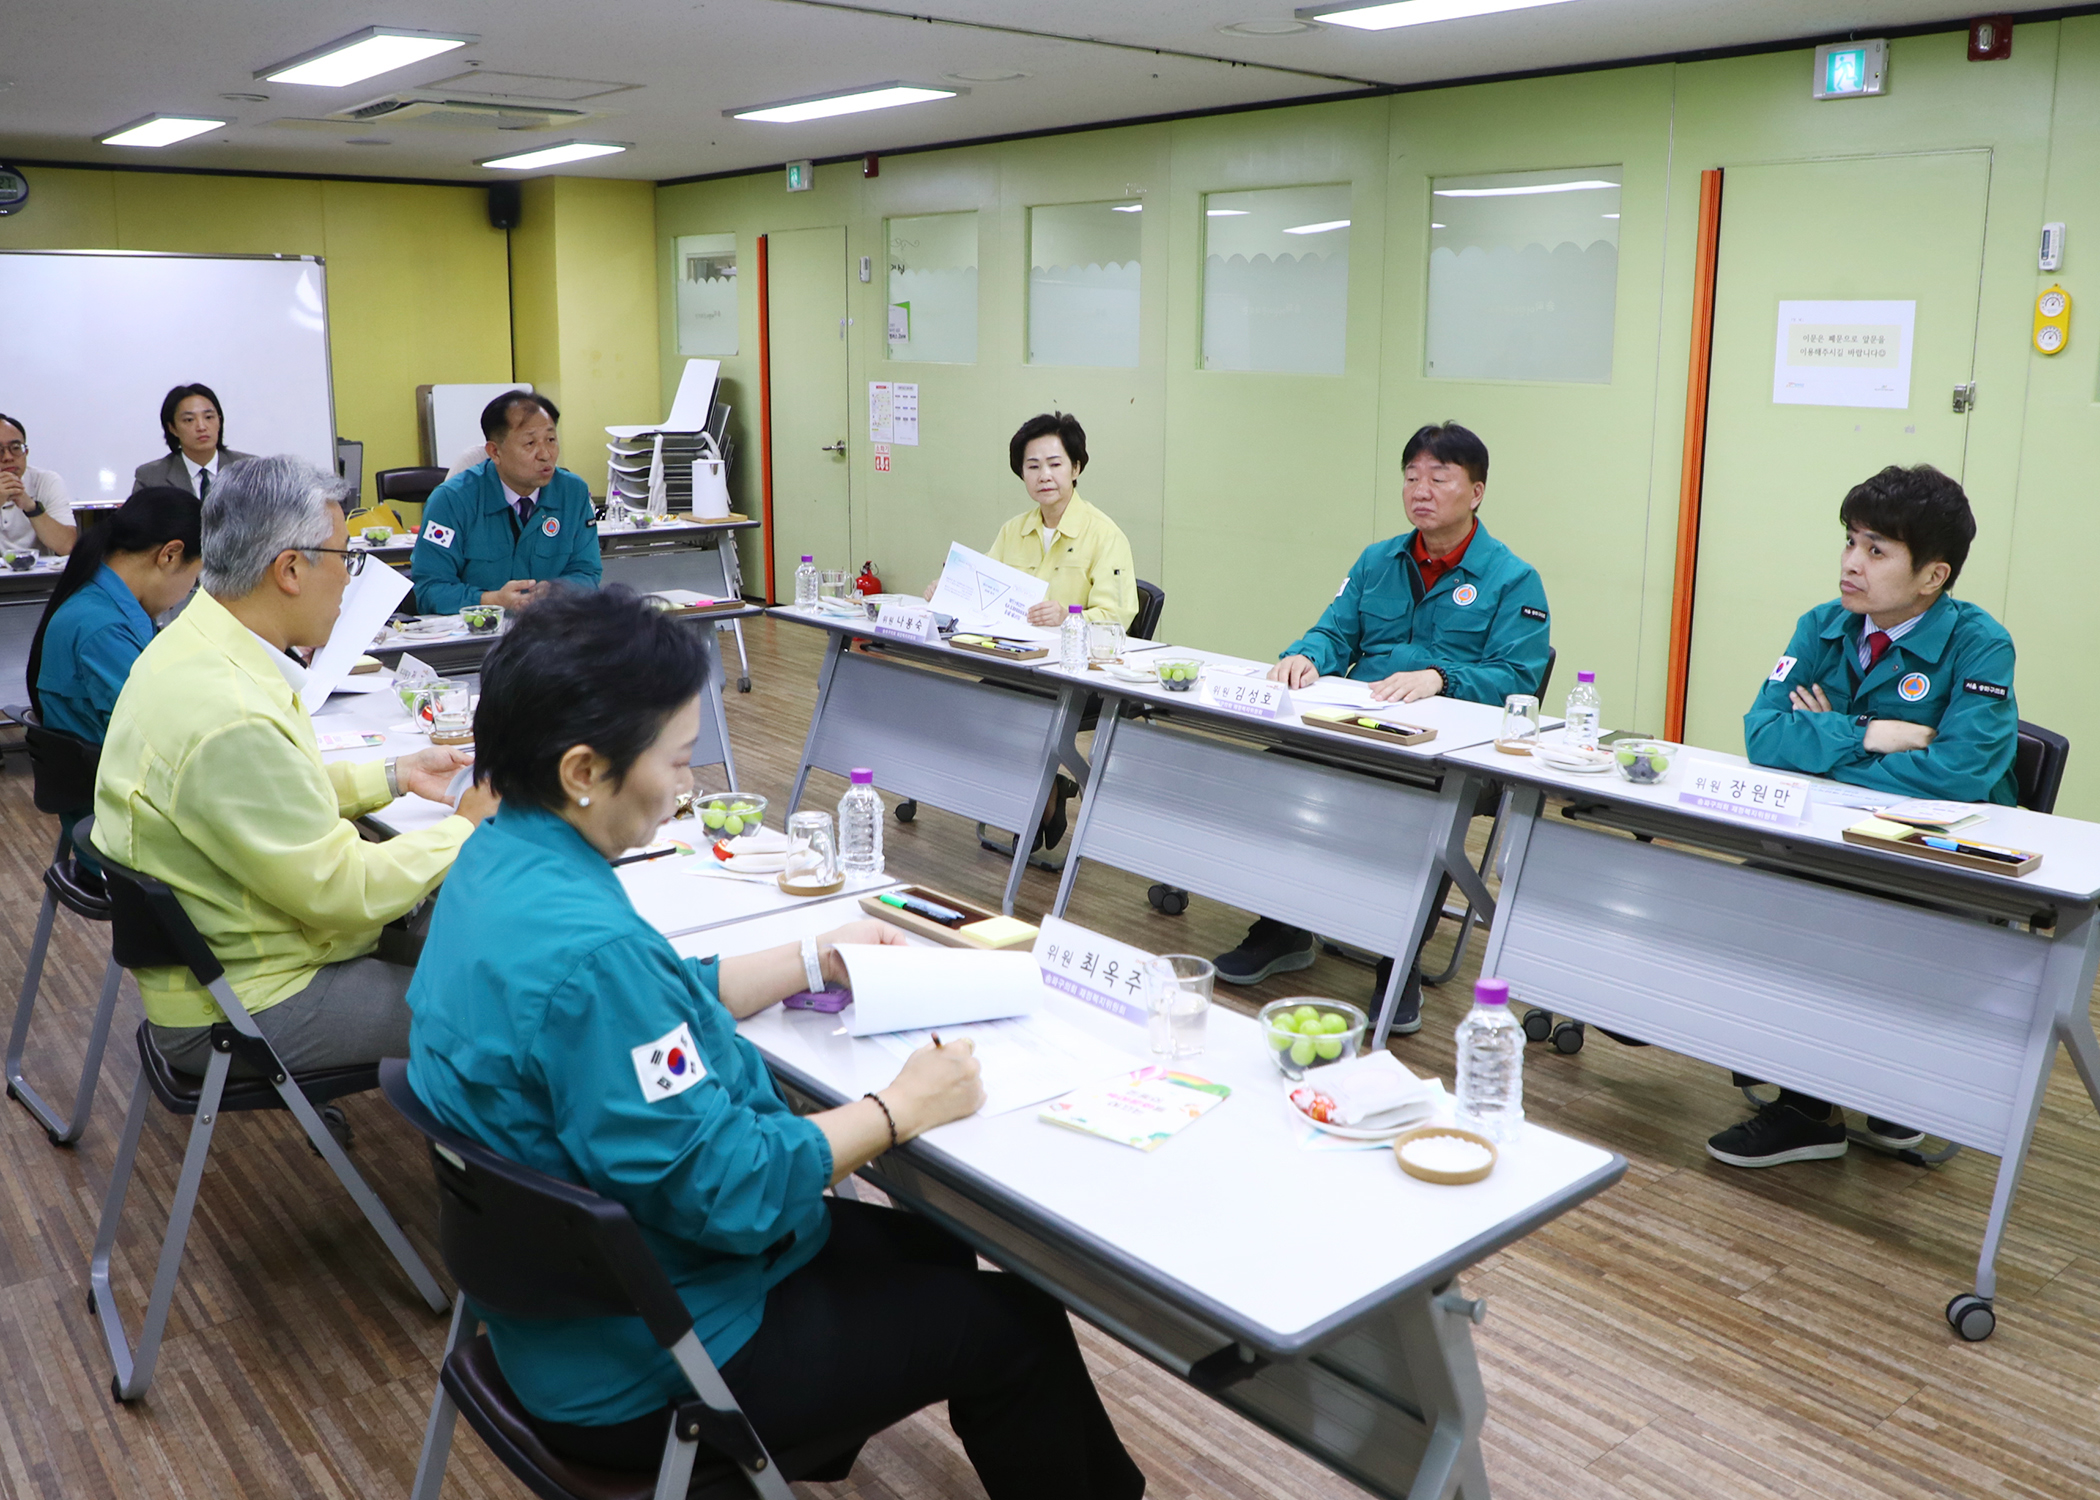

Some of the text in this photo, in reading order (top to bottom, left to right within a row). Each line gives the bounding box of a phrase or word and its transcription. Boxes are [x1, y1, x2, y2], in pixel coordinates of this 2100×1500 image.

[896, 615, 922, 632] 나봉숙
[1213, 685, 1230, 698] 위원
[1235, 686, 1272, 706] 김성호
[1965, 682, 1977, 690] 서울
[1695, 777, 1721, 793] 위원
[1730, 779, 1791, 809] 장원만
[1047, 944, 1074, 969] 위원
[1080, 951, 1142, 995] 최옥주
[1044, 973, 1128, 1017] 송파구의회 재정복지위원회
